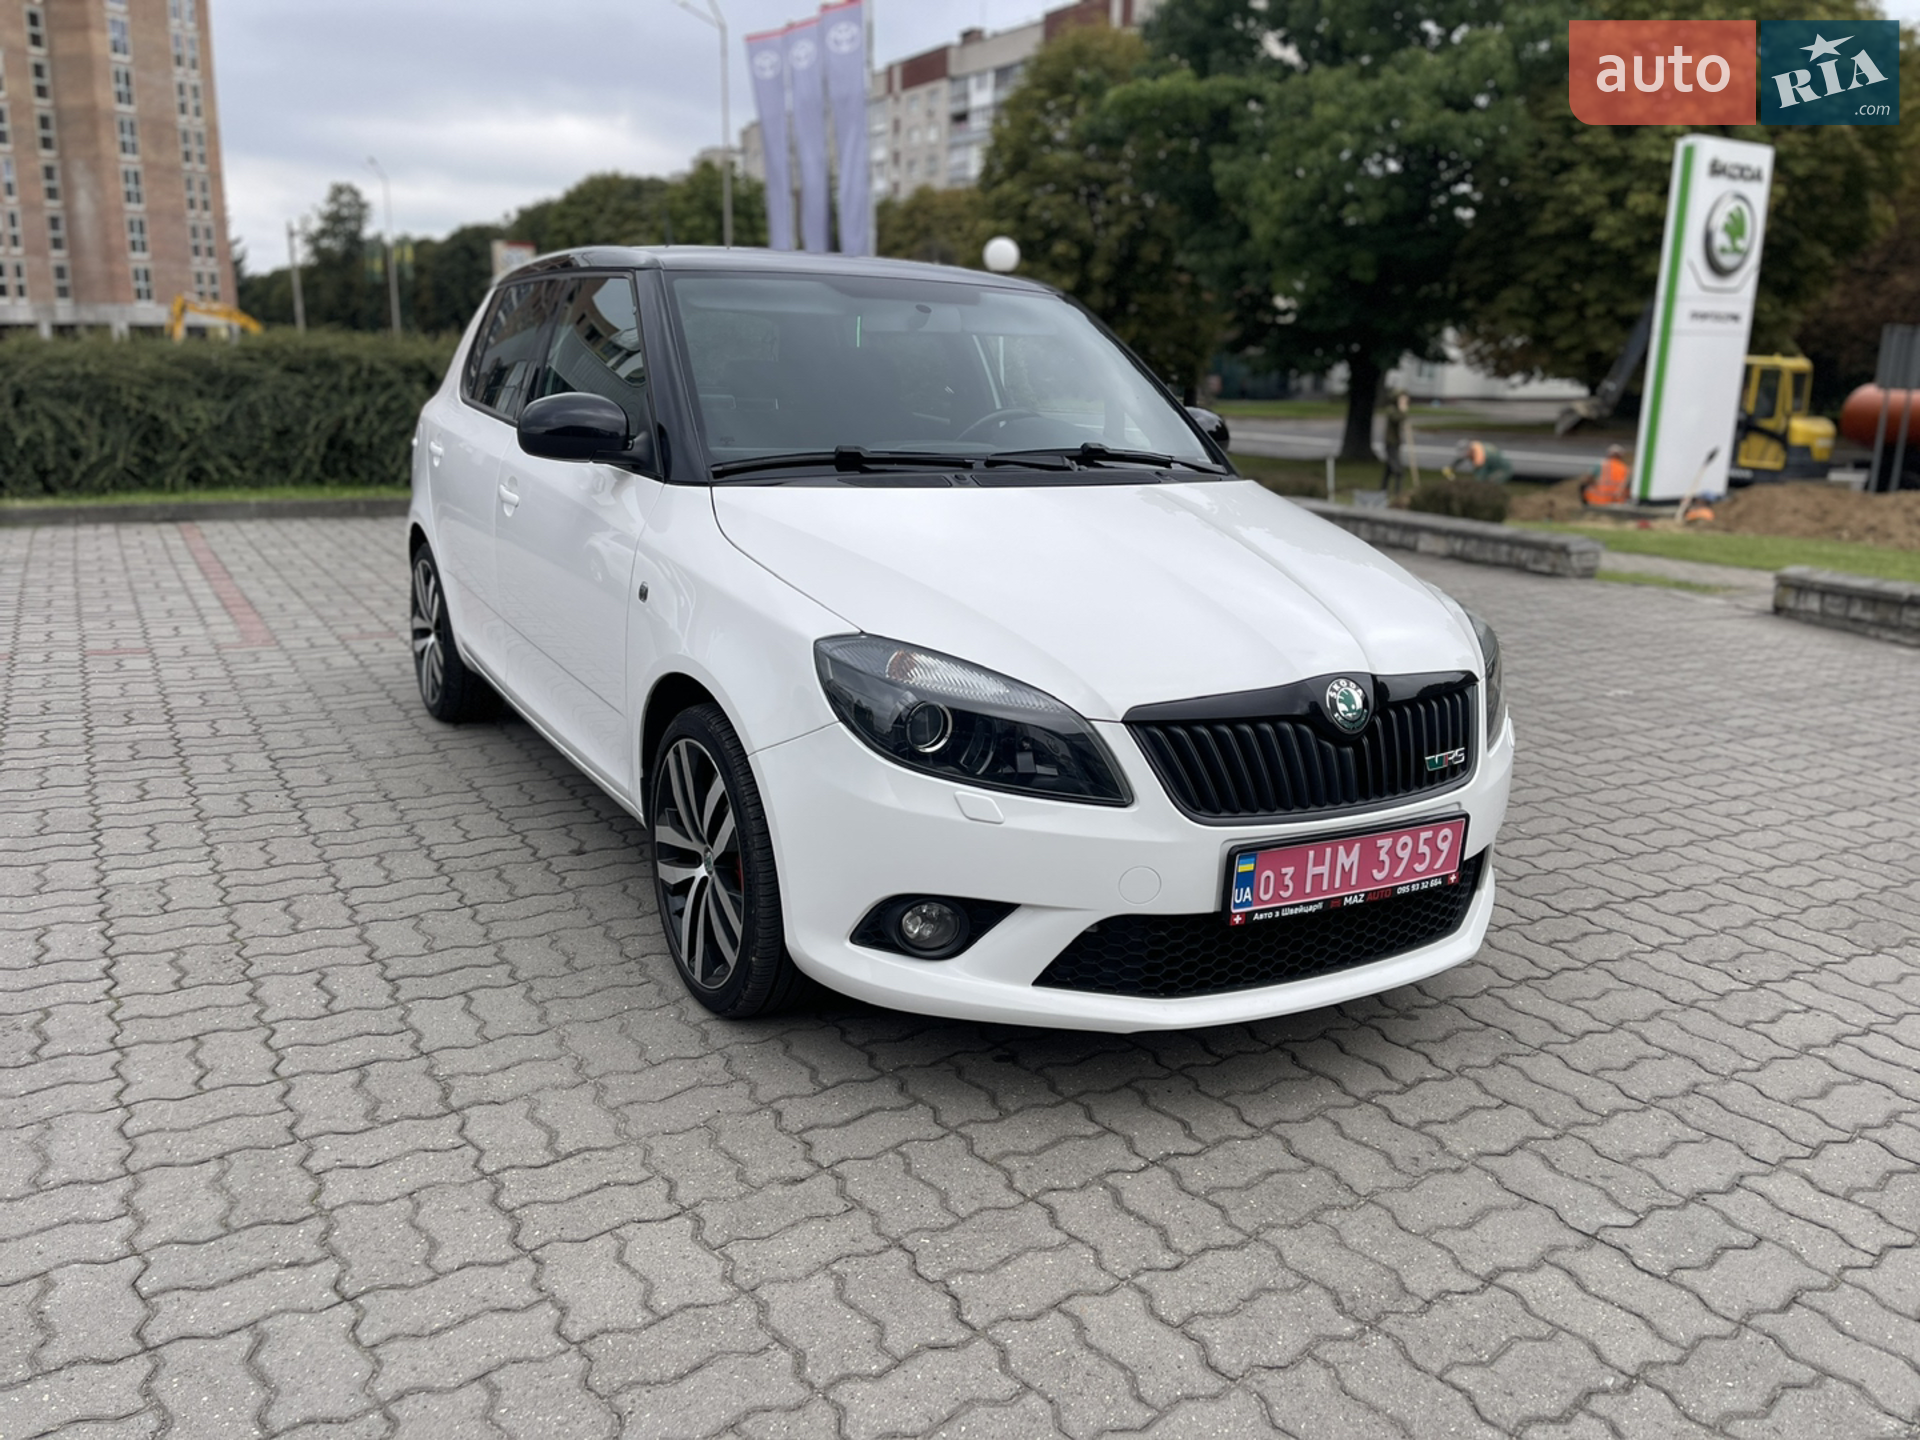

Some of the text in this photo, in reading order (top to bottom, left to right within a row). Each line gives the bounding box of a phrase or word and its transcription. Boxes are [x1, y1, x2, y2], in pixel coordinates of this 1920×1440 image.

[1258, 827, 1453, 901] 03 HM 3959
[1234, 887, 1252, 904] UA
[1343, 888, 1392, 906] MAZ AUTO
[1252, 912, 1273, 921] Авто
